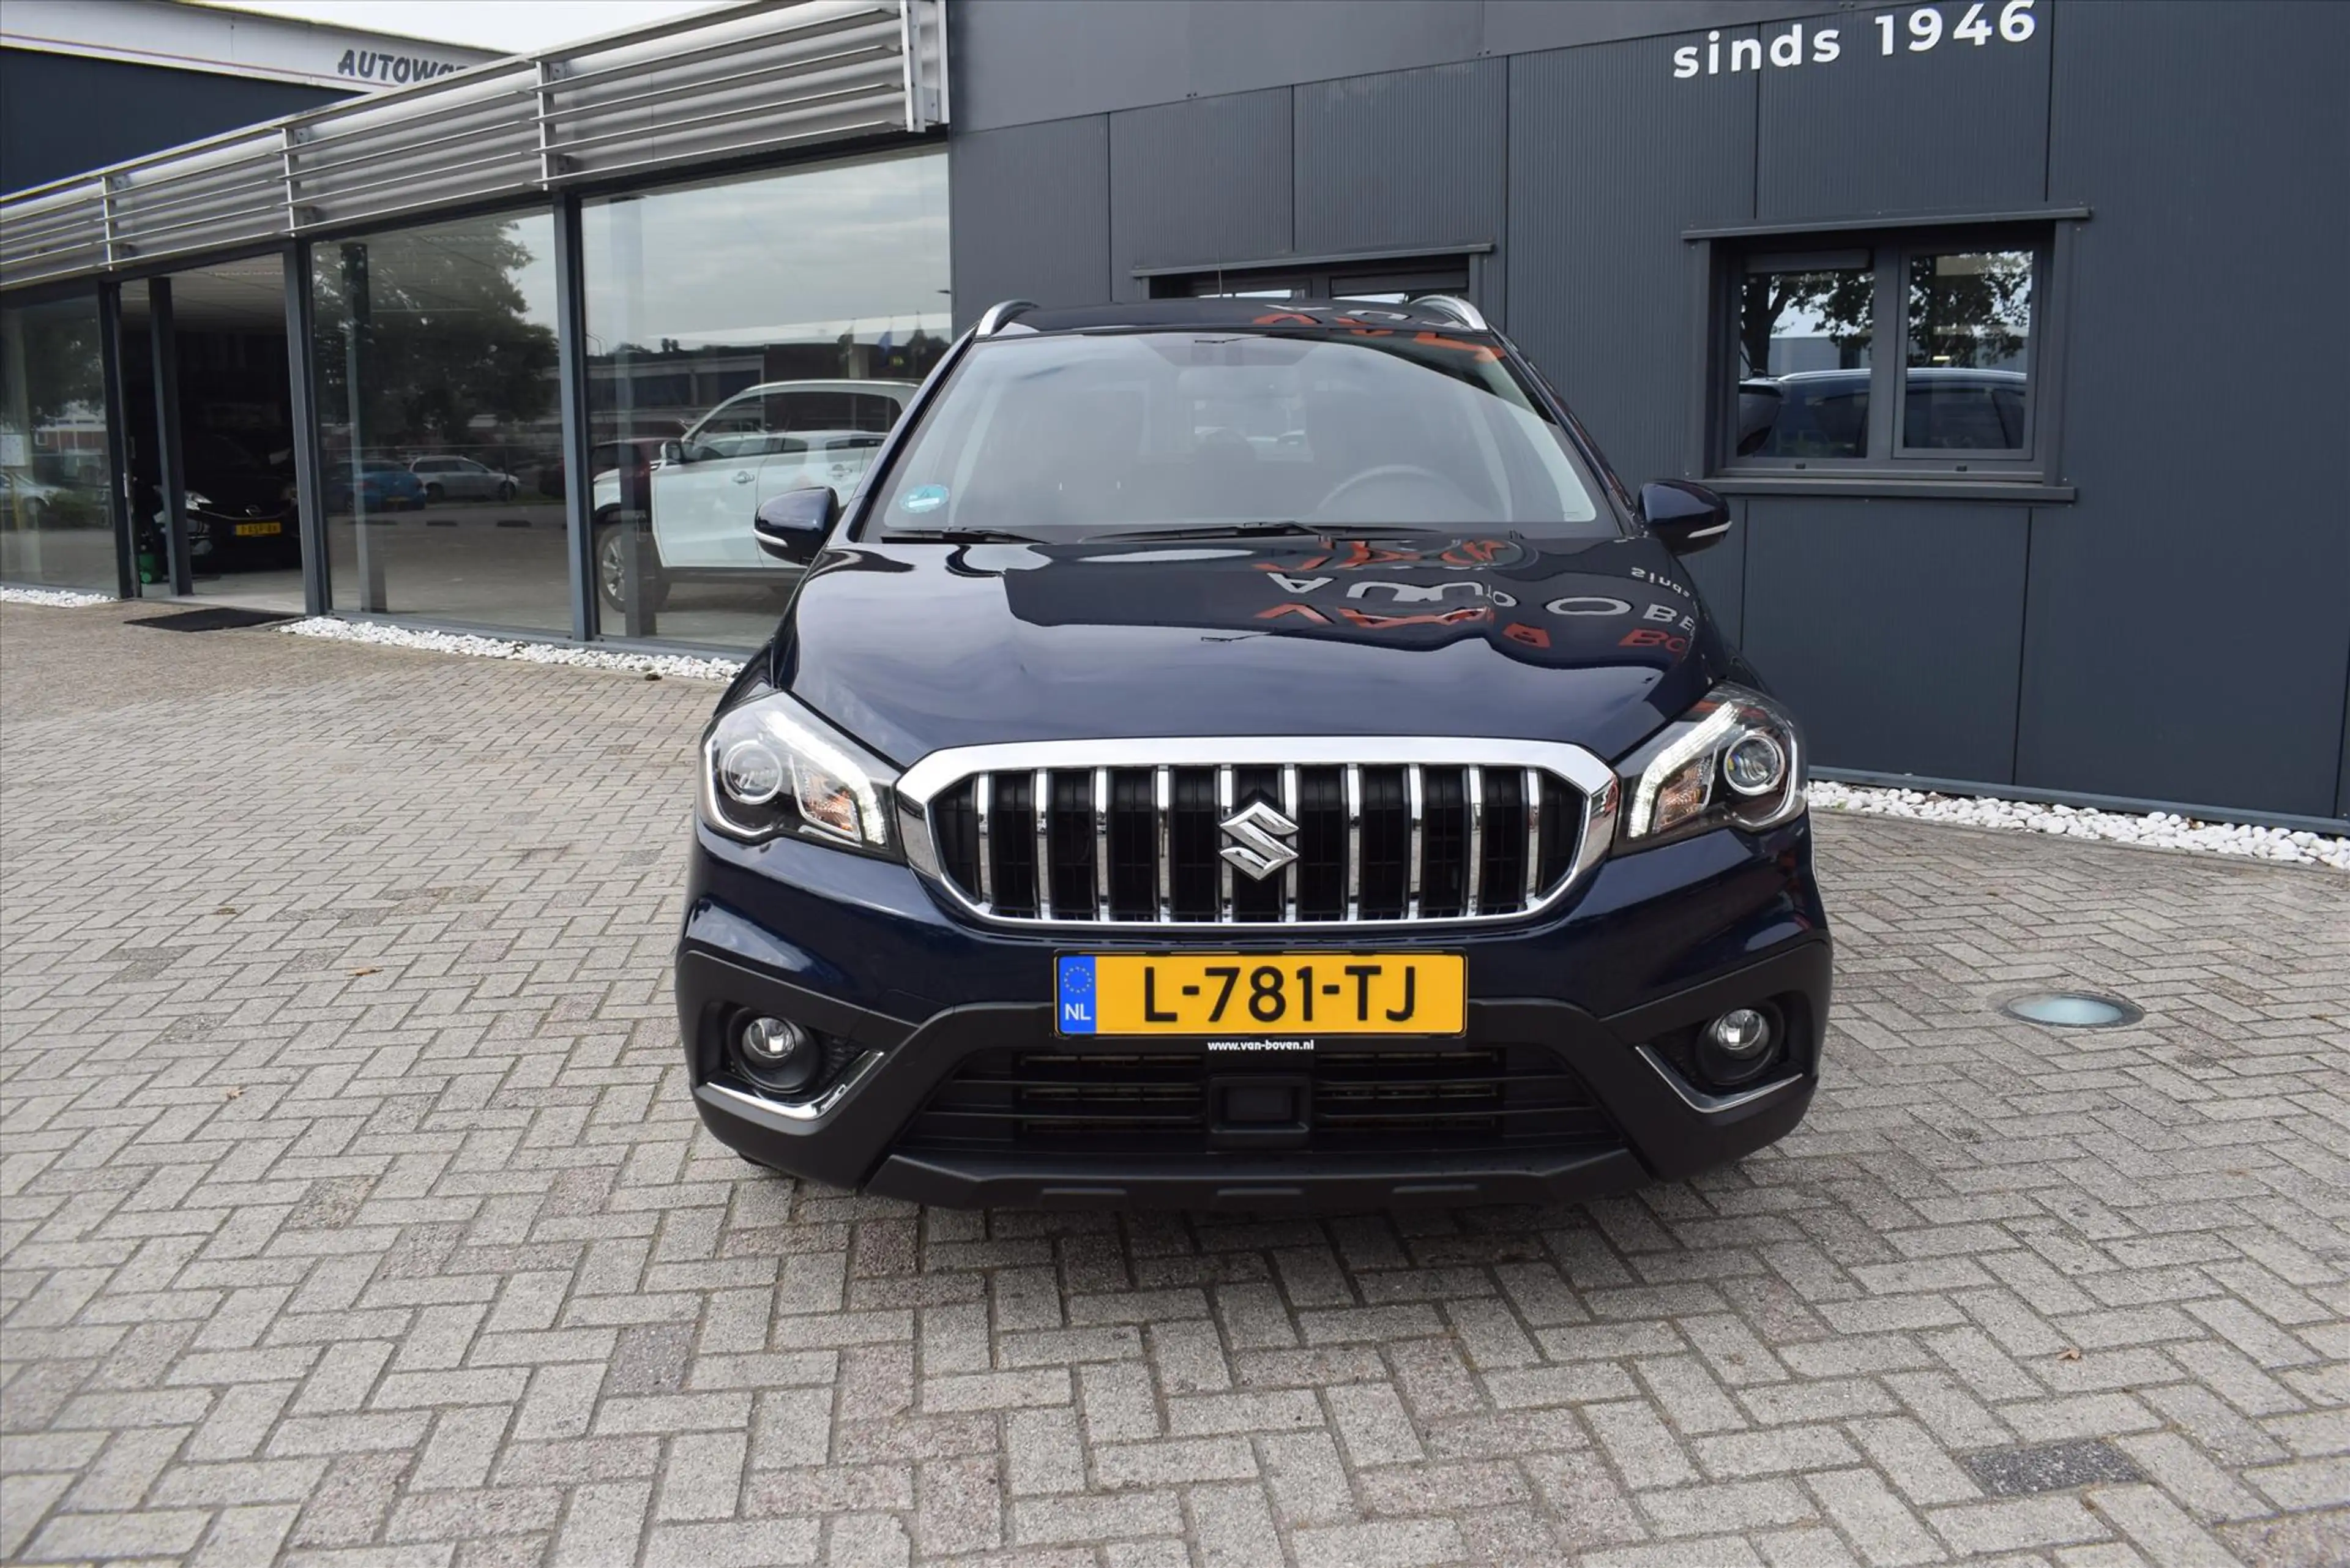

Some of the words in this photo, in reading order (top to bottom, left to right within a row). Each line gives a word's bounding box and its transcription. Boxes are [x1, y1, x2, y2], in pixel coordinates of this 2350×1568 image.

[1674, 24, 1841, 78] sinds
[1874, 0, 2036, 56] 1946
[338, 49, 468, 83] AUTOW
[1065, 1004, 1091, 1020] NL
[1144, 966, 1416, 1022] L-781-TJ
[1207, 1039, 1314, 1050] www.van-boven.nl
